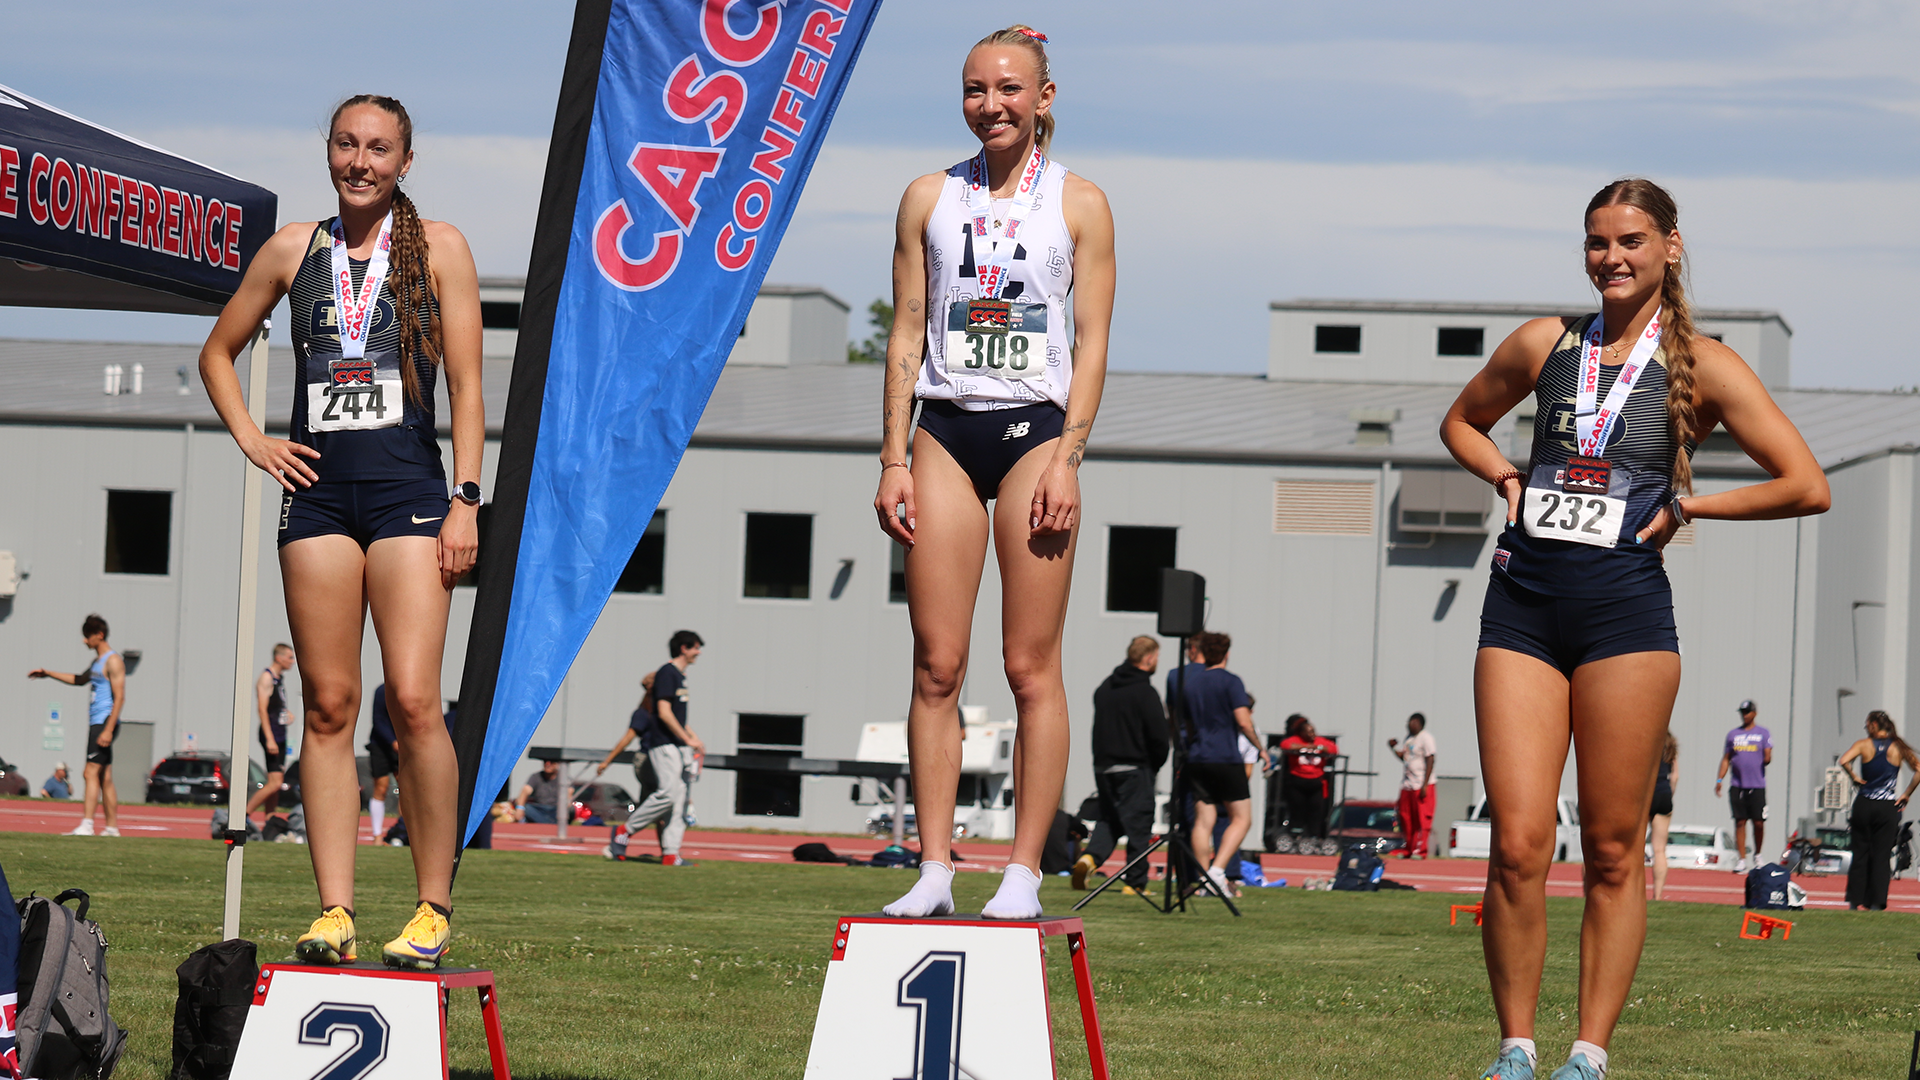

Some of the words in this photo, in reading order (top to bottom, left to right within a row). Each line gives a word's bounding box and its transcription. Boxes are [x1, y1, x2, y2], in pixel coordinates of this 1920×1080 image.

[28, 152, 242, 272] CONFERENCE
[350, 275, 376, 341] CASCADE
[360, 308, 373, 342] COLLEGIATE
[367, 277, 382, 309] CONFERENCE
[970, 301, 1009, 309] CASCADE
[970, 310, 1009, 324] CCC
[332, 361, 372, 369] CASCADE
[964, 333, 1029, 371] 308
[1586, 330, 1601, 393] CASCADE
[334, 370, 372, 383] CCC
[1579, 361, 1587, 393] CONFERENCE
[322, 384, 387, 421] 244
[1598, 411, 1616, 448] CONFERENCE
[1569, 458, 1610, 468] CASCADE
[1569, 468, 1609, 483] CCC
[1536, 493, 1607, 535] 232
[893, 951, 966, 1080] 1
[298, 1001, 391, 1080] 2
